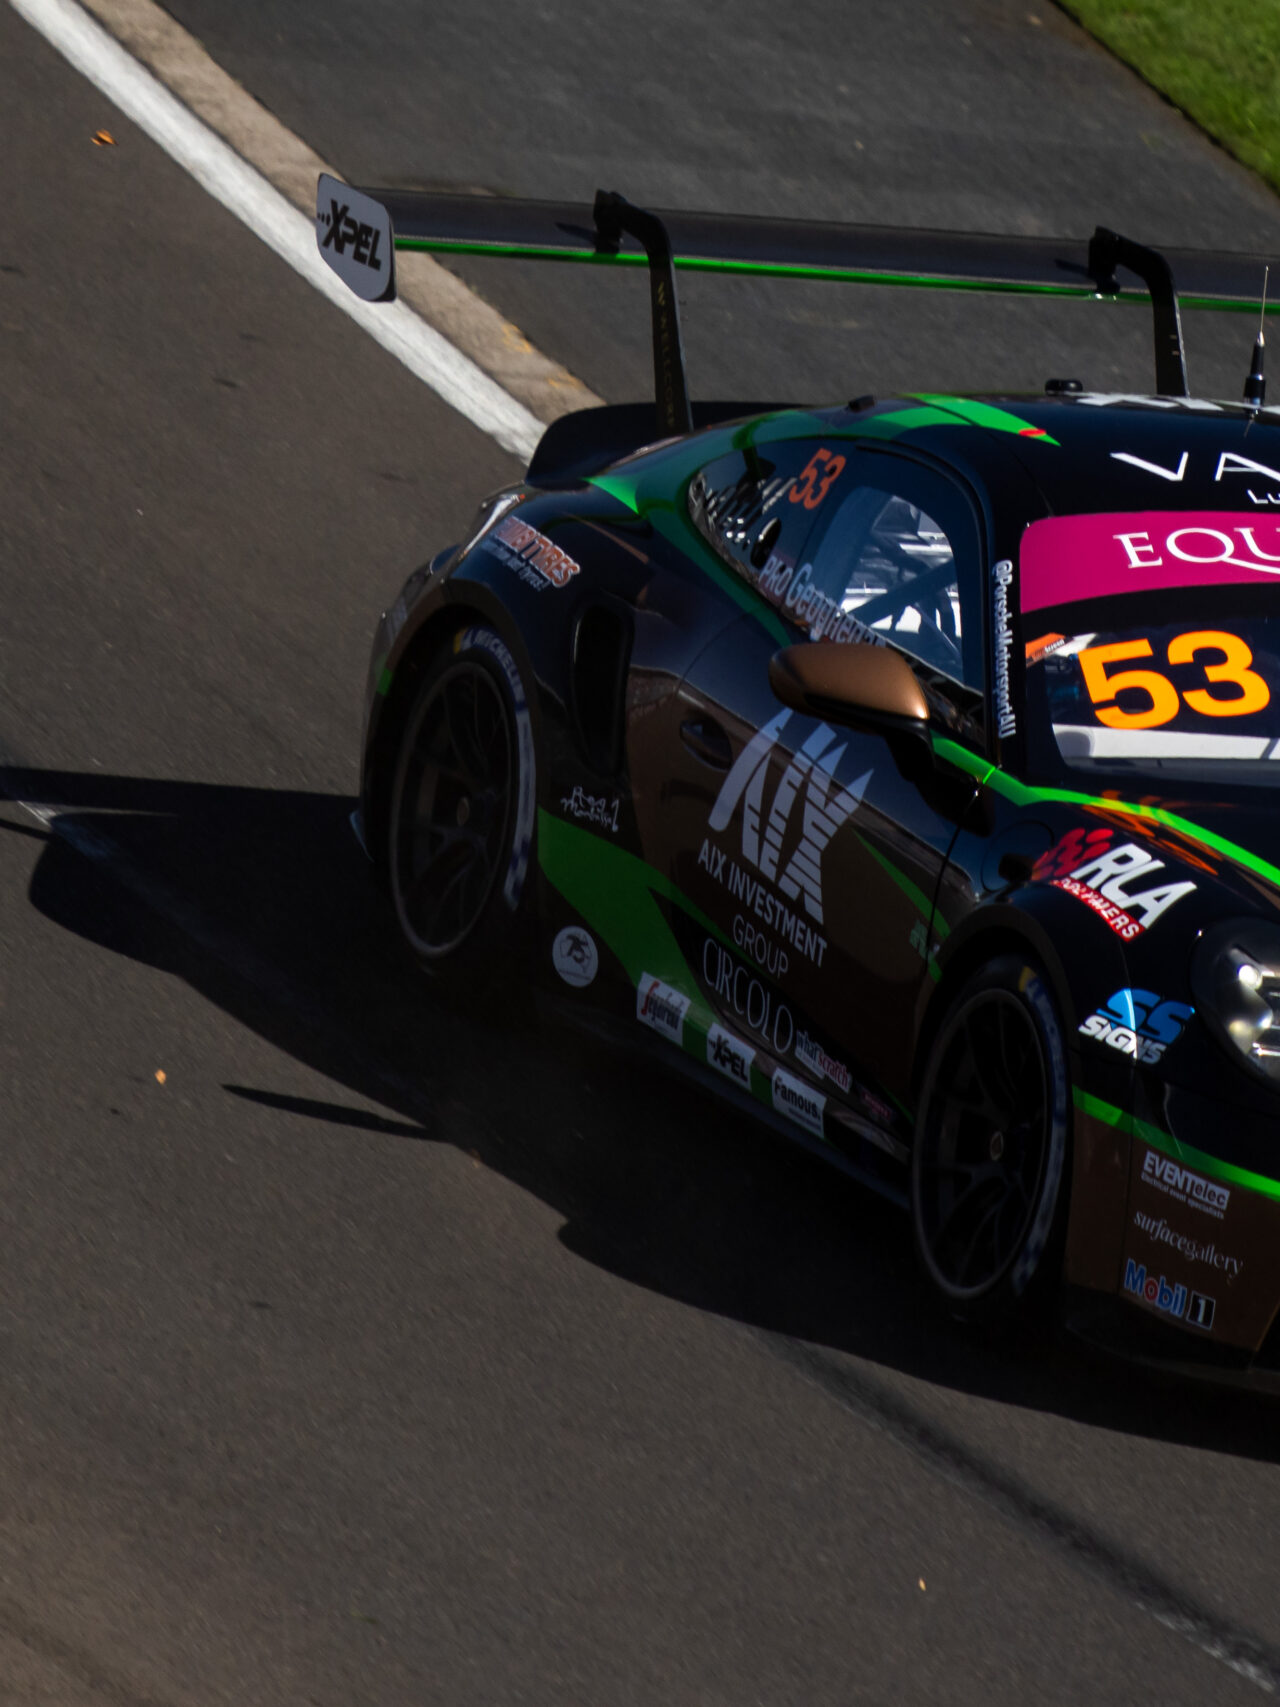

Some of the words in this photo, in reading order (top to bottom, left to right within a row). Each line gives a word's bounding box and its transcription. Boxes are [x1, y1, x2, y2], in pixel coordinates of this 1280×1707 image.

[322, 198, 381, 271] XPEL
[788, 448, 848, 510] 53
[1079, 629, 1271, 731] 53
[697, 838, 727, 885] AIX
[727, 861, 829, 969] INVESTMENT
[732, 913, 790, 979] GROUP
[703, 937, 794, 1054] CIRCOLO
[1142, 1149, 1231, 1211] EVENTelec
[1124, 1258, 1188, 1319] Mobil
